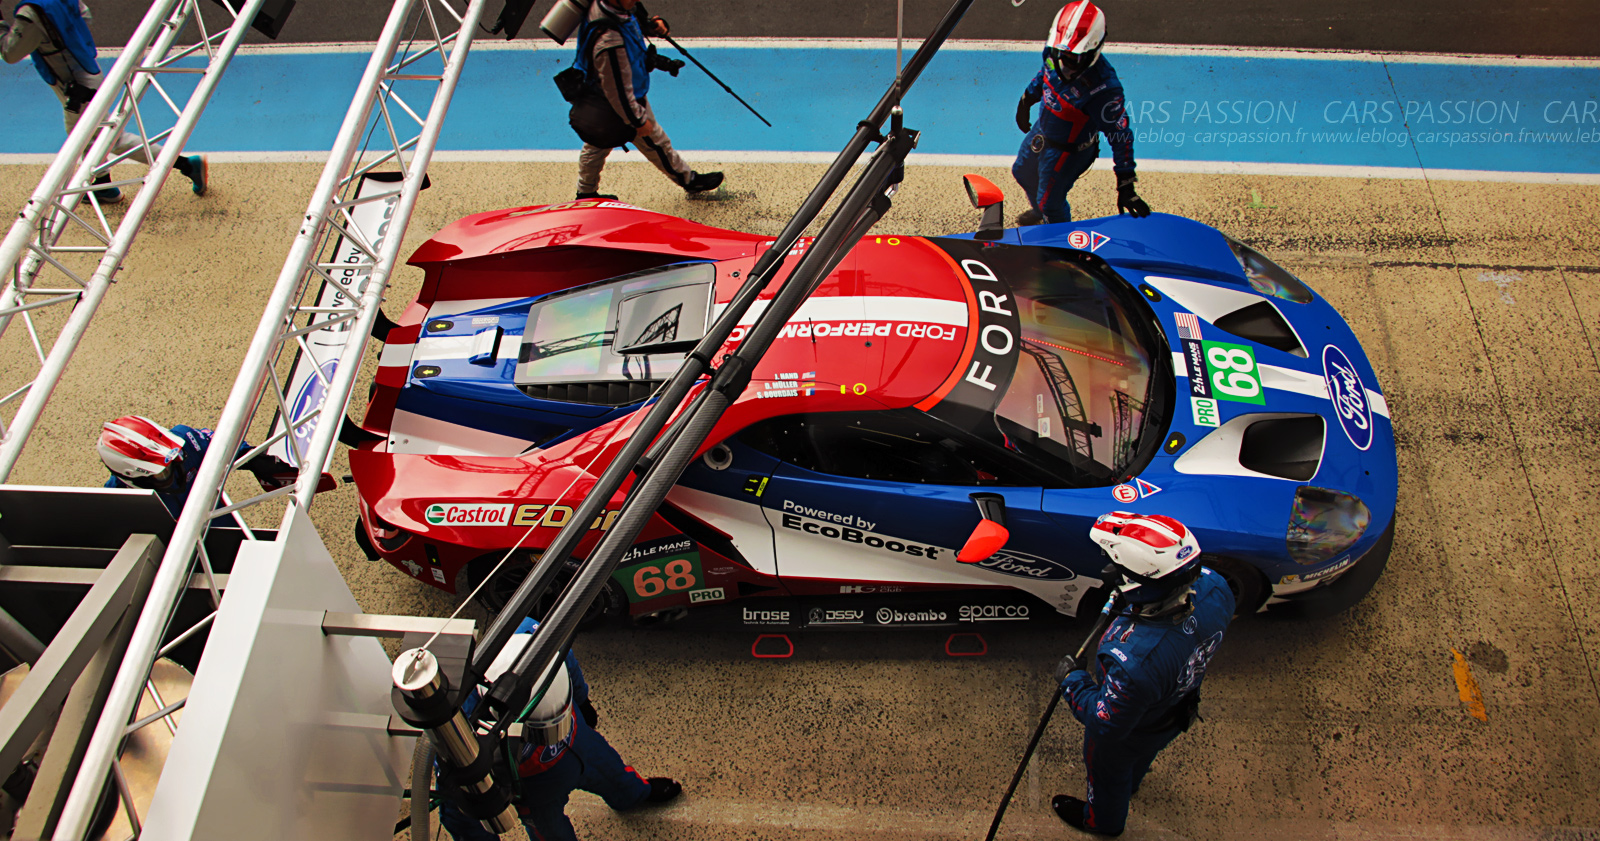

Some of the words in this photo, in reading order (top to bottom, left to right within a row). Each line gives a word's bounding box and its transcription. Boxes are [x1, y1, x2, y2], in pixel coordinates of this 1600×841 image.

[896, 325, 957, 341] FORD
[961, 258, 1013, 391] FORD
[780, 372, 799, 380] HAND
[1207, 346, 1260, 398] 68
[763, 389, 799, 399] BOURDAIS
[772, 381, 799, 389] MÜLLER
[1330, 360, 1369, 430] Ford
[1196, 399, 1216, 425] PRO
[446, 505, 507, 524] Castrol
[783, 499, 853, 525] Powered
[856, 515, 876, 531] by
[782, 513, 939, 561] EcoBoost
[643, 546, 657, 556] LE
[658, 540, 691, 553] MANS
[982, 551, 1051, 578] Ford
[1303, 558, 1349, 580] MICHELIN
[633, 558, 696, 598] 68
[691, 589, 723, 602] PRO
[743, 607, 790, 620] brose
[826, 610, 864, 620] DSSV
[894, 609, 947, 622] brembo
[959, 605, 1030, 623] sparco
